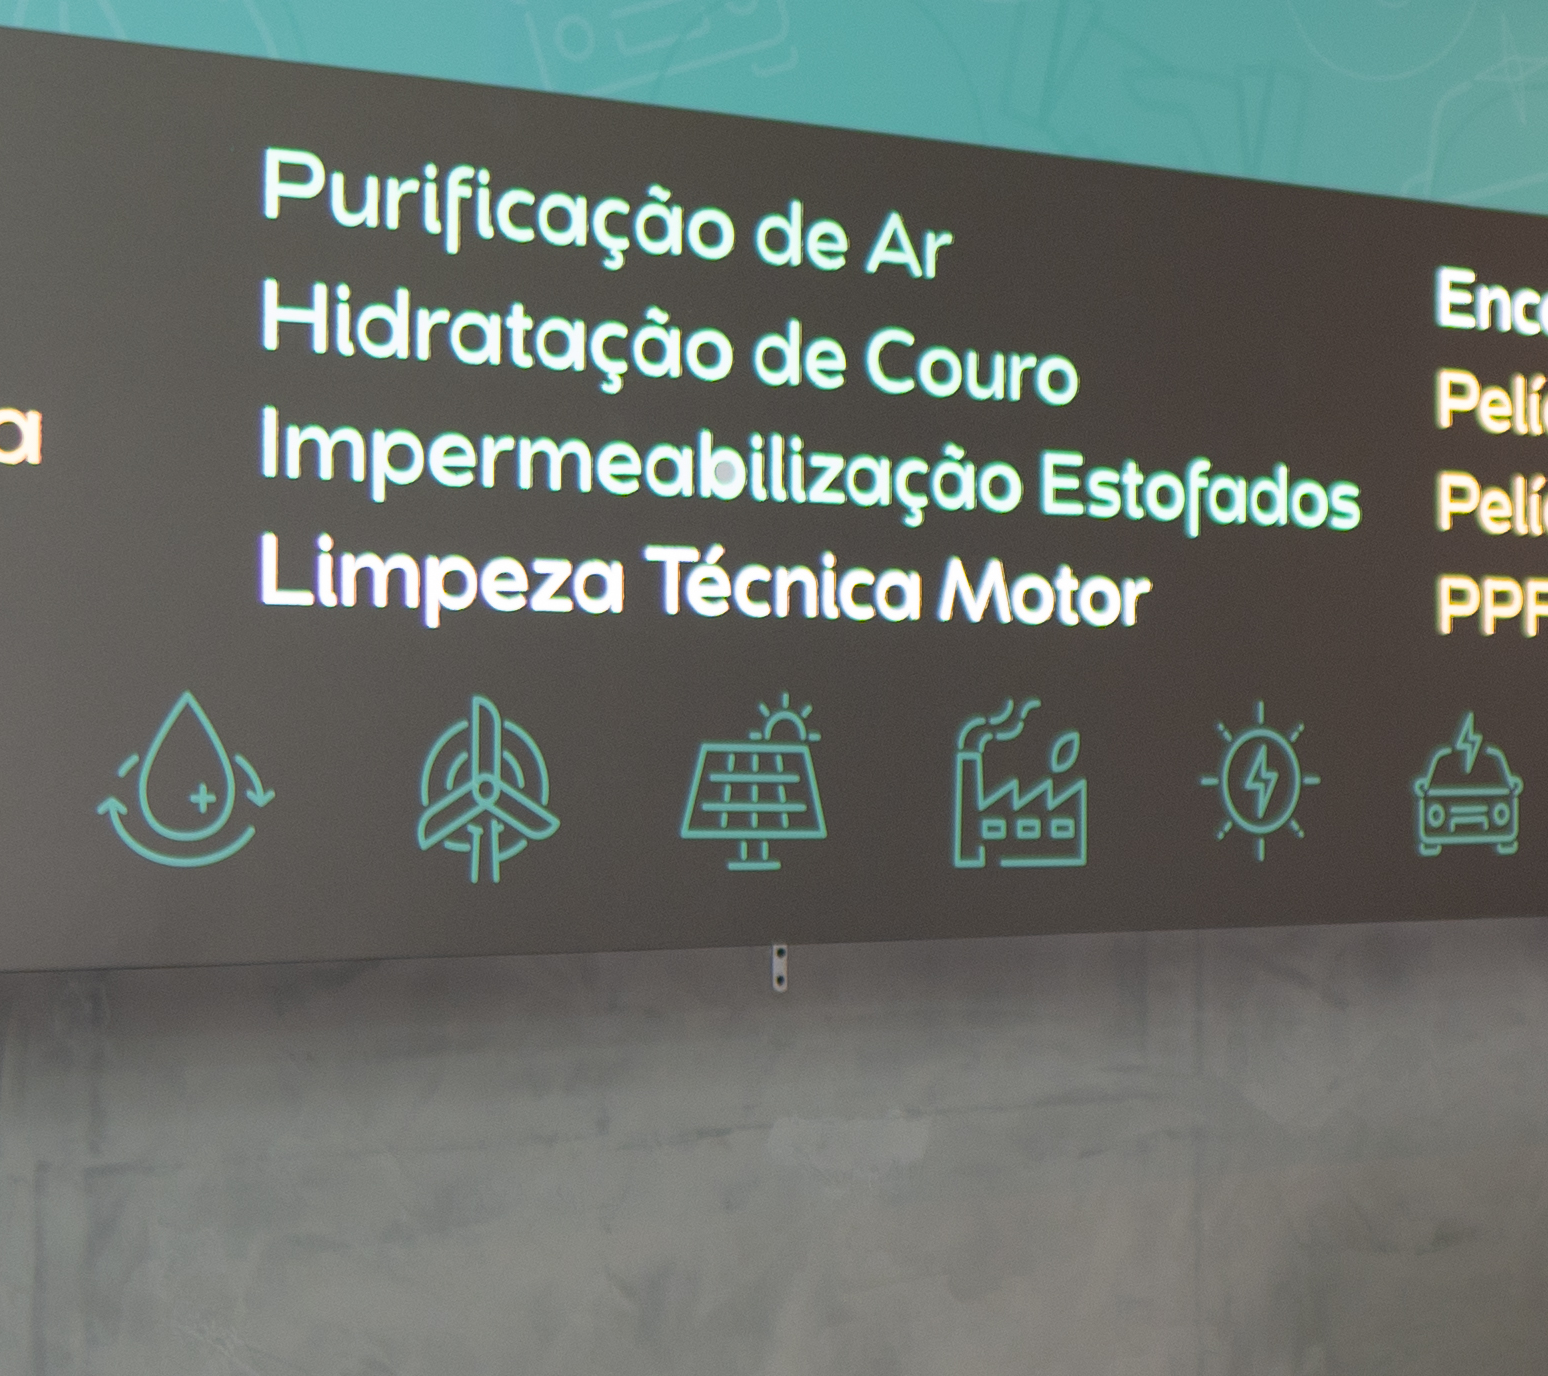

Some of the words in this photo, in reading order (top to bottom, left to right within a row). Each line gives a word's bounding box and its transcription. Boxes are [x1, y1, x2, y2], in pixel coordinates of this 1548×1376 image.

[262, 146, 736, 271] Purificação
[754, 200, 849, 272] de
[865, 211, 954, 280] Ar
[261, 278, 735, 395] Hidratação
[752, 319, 848, 391] de
[865, 328, 1080, 406] Couro
[260, 404, 1023, 528] Impermeabilização
[1040, 451, 1362, 538] Estofados
[259, 532, 626, 629] Limpeza
[641, 543, 923, 622] Técnica
[936, 556, 1153, 628] Motor
